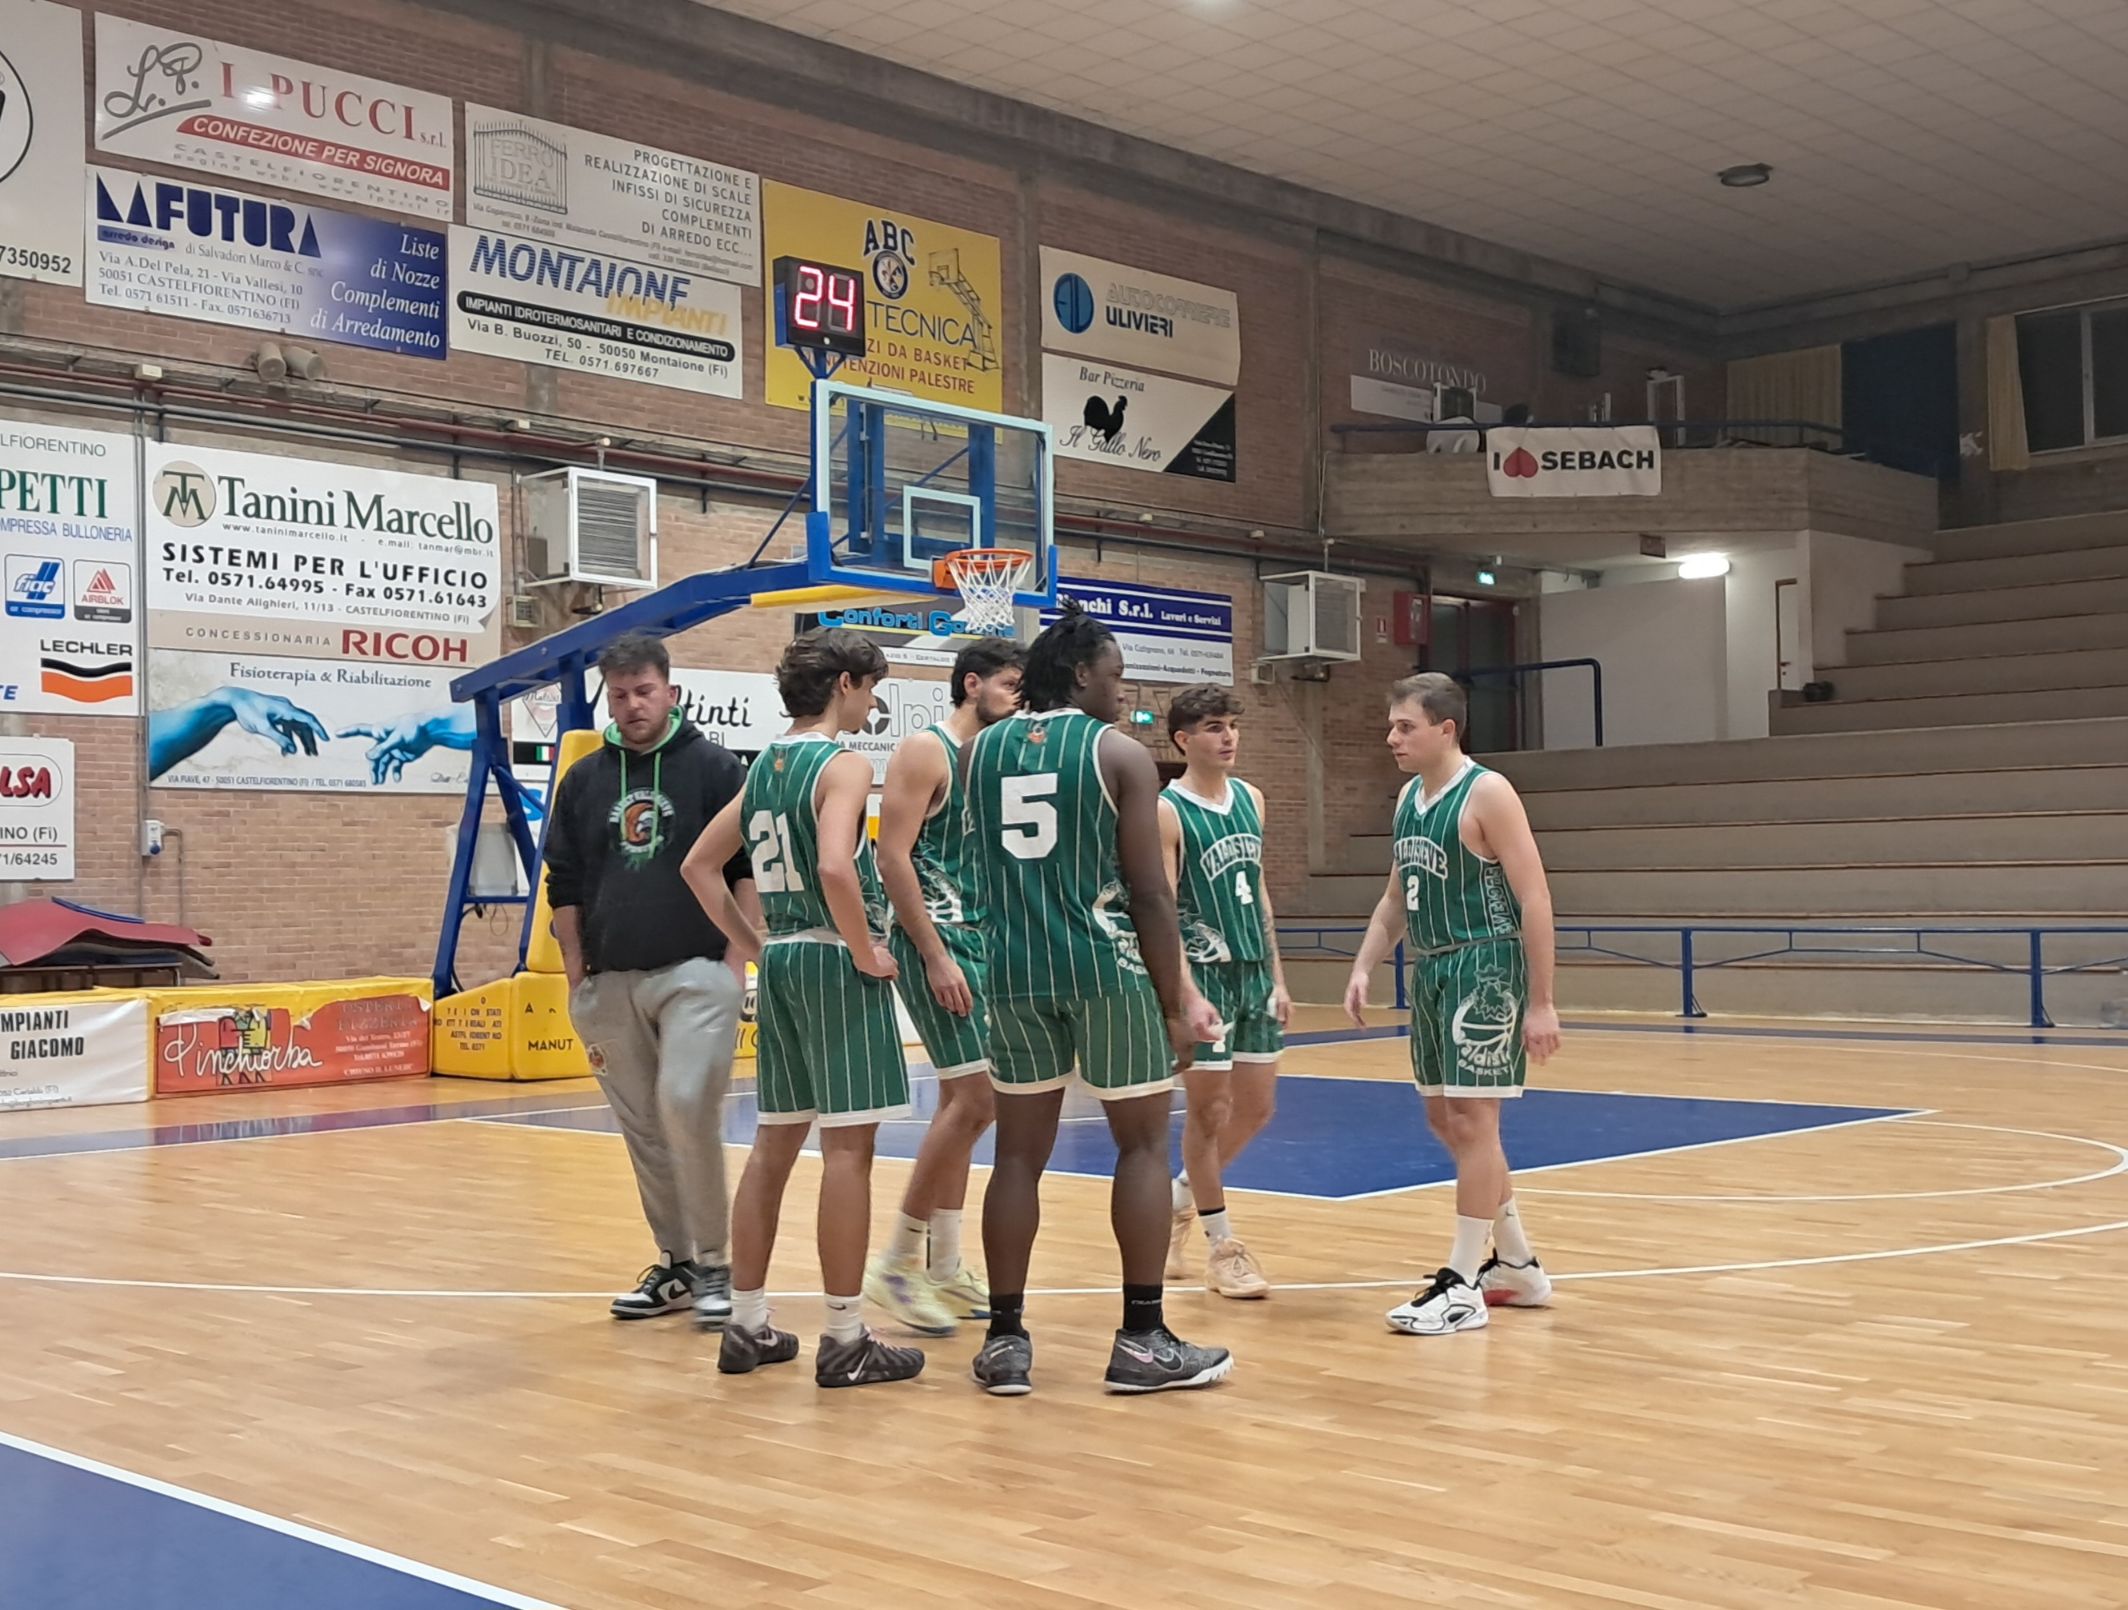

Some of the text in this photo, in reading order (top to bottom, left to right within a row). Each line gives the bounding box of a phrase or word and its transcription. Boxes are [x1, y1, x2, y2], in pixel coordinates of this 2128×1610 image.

[220, 61, 447, 148] I PUCCI s.r.l.
[193, 117, 443, 186] CONFEZIONE PER SIGNORA
[174, 143, 449, 208] CASTELFIORENTINO
[489, 157, 552, 190] IDEA
[584, 154, 751, 206] REALIZZAZIONE DI SCALE
[634, 149, 752, 190] PROGETTAZIONE E
[612, 179, 752, 223] INFISSI DI SICUREZZA
[642, 221, 655, 235] DI
[660, 226, 711, 248] ARREDO
[662, 208, 752, 240] COMPLEMENTI
[141, 235, 175, 250] design
[185, 243, 195, 255] di
[249, 253, 281, 271] Marco
[283, 262, 292, 272] &
[401, 234, 439, 260] Liste
[863, 219, 916, 266] ABC
[99, 251, 120, 265] Via
[165, 261, 194, 278] Pela,
[198, 268, 209, 279] 21
[221, 271, 241, 285] Via
[245, 273, 287, 294] Vallesi,
[291, 284, 303, 296] 10
[99, 267, 300, 310] 50051 CASTELFIORENTINO (FI)
[370, 258, 439, 289] di Nozze
[469, 234, 691, 311] MONTAIONE
[99, 283, 121, 297] Tel.
[125, 287, 152, 302] 0571
[156, 292, 189, 308] 61511
[227, 304, 291, 324] 0571636713
[331, 280, 439, 319] Complementi
[606, 291, 729, 336] IMPIANTI
[793, 265, 856, 332] 24
[310, 308, 440, 348] di Arredamento
[465, 296, 729, 358] IMPIANTI IDROTERMOSANITARI E CONDIZIONAMENTO
[866, 300, 977, 347] TECNICA
[1106, 305, 1174, 338] ULIVIERI
[468, 318, 728, 379] Via B. Buozzi, 50 50050 Montaione (Fi)
[888, 341, 969, 372] DA BASKET
[579, 354, 660, 379] 0571.697667
[909, 370, 976, 394] PALESTRE
[1079, 366, 1145, 392] Bar Pizzeria
[0, 433, 106, 457] LFIORENTINO
[1088, 425, 1126, 457] Gallo
[1128, 437, 1161, 462] Nero
[1493, 449, 1654, 471] I SEBACH
[0, 468, 108, 519] PETTI
[217, 475, 494, 544] Tanini Marcello
[62, 522, 133, 543] BULLONERIA
[222, 522, 348, 543] www.taninimarcello.it
[162, 542, 488, 590] SISTEMI PER L'UFFICIO
[14, 573, 55, 595] fiac
[81, 594, 125, 606] AIRBLOK
[162, 567, 487, 608] Tel. 0571.64995 Fax 0571.61643
[185, 592, 204, 602] Via
[208, 593, 243, 606] Dante
[246, 597, 300, 611] Alighieri,
[304, 601, 334, 612] 11/13
[345, 605, 450, 622] CASTELFIORENTINO
[818, 607, 923, 630] Conforti
[1119, 600, 1153, 619] S.r.l.
[40, 639, 133, 657] LECHLER
[185, 626, 468, 663] CONCESSIONARIA RICOH
[229, 662, 432, 688] Fisioterapia & Riabilitazione
[236, 776, 298, 787] CASTELFIORENTINO
[1001, 773, 1058, 859] 5
[33, 826, 58, 842] (Fi)
[749, 810, 804, 893] 21
[1235, 870, 1254, 905] 4
[1406, 875, 1420, 911] 2
[0, 1010, 69, 1033] MPIANTI
[11, 1037, 84, 1060] GIACOMO
[528, 1038, 573, 1051] MANUT
